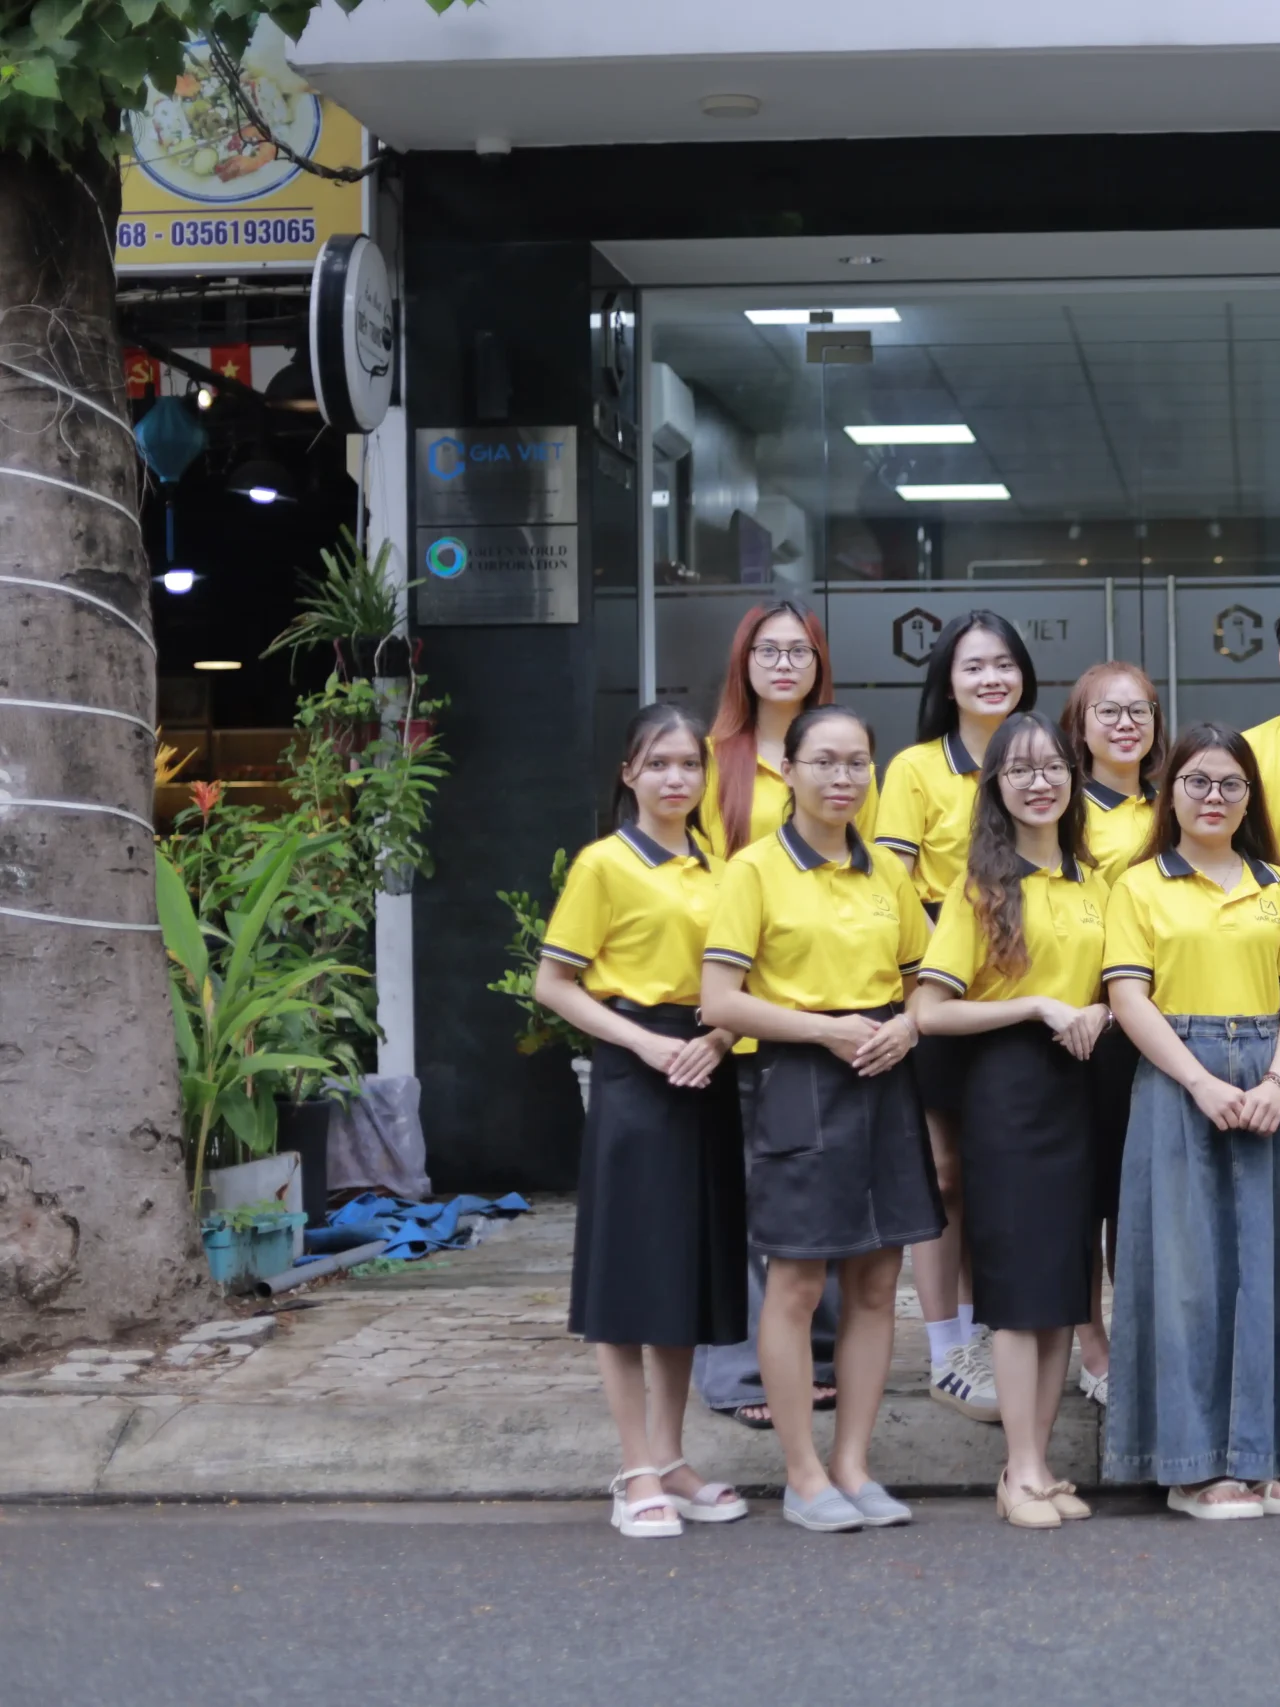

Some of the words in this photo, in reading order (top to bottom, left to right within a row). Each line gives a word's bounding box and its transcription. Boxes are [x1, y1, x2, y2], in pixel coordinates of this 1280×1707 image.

[116, 221, 147, 248] 68
[171, 219, 315, 247] 0356193065
[469, 443, 511, 462] GIA
[518, 545, 568, 557] WORLD
[468, 558, 568, 571] CORPORATION
